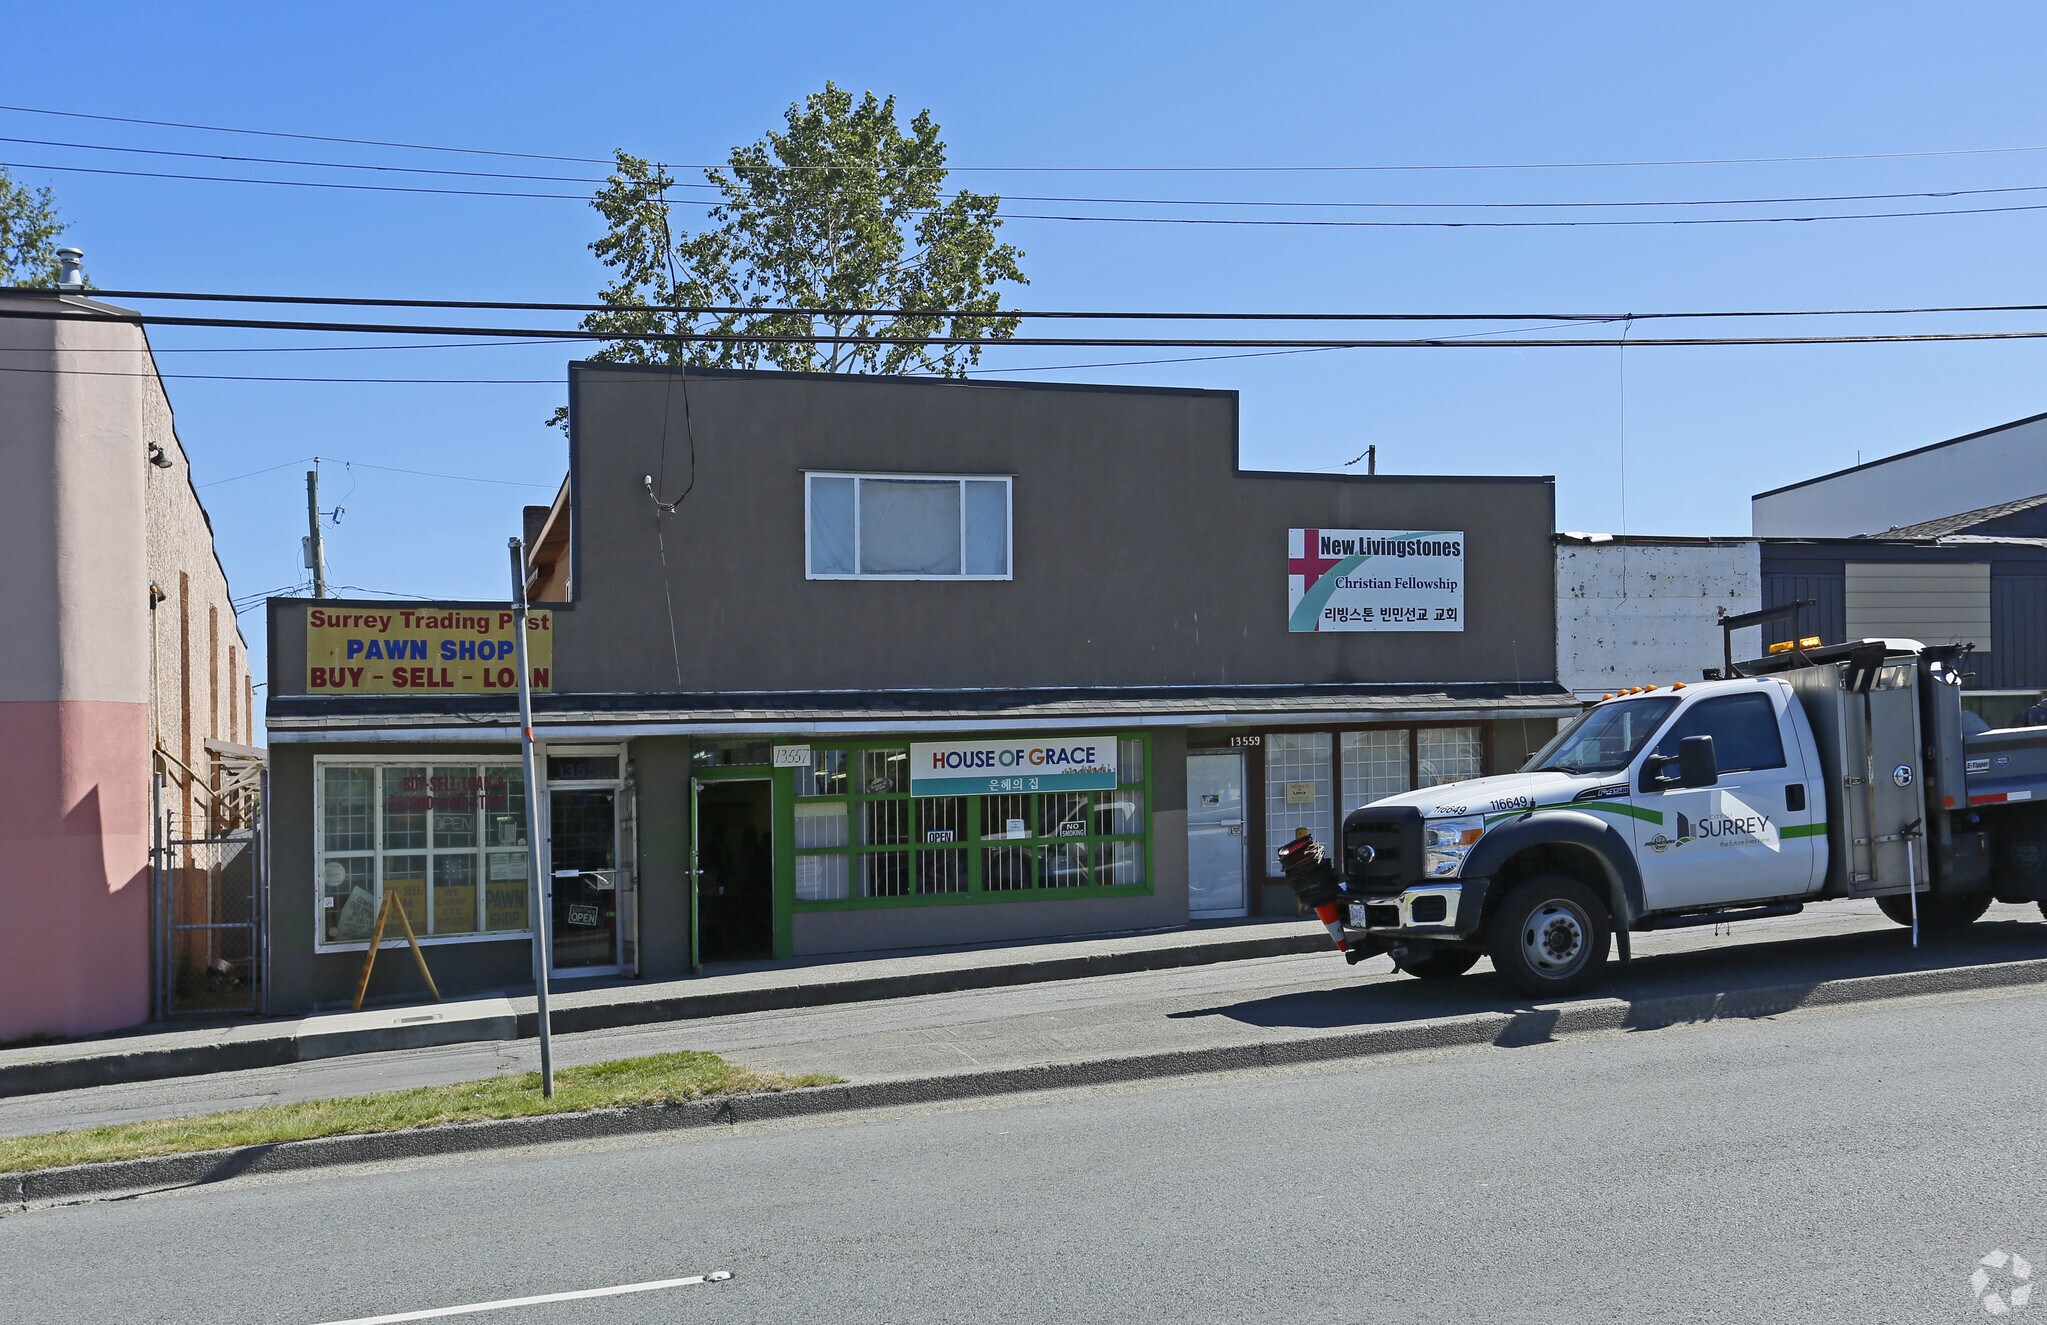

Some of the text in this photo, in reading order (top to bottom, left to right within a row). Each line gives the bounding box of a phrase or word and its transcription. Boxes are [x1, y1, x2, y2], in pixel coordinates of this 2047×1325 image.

[1320, 536, 1461, 558] New Livingstones
[1335, 576, 1458, 593] Christian Fellowship
[310, 609, 550, 634] Surrey Trading Pst
[1324, 607, 1457, 622] 리빙스톤 빈민선교 교회
[346, 639, 514, 661] PAWN SHOP
[310, 667, 364, 688] BUY
[392, 667, 454, 688] SELL
[483, 667, 549, 688] LON
[1230, 736, 1260, 747] 13559
[775, 748, 810, 764] 13557
[932, 746, 1095, 769] HOUSE OF GRACE
[988, 778, 1039, 792] 은혜의 집
[1434, 805, 1467, 815] 116649
[1489, 796, 1528, 811] 116649
[432, 816, 472, 831] OPEN
[1698, 815, 1770, 838] SURREY
[928, 832, 952, 843] OPEN
[1062, 829, 1084, 837] SMOKING
[486, 889, 524, 909] PAWN
[490, 911, 519, 927] SHOP
[571, 912, 595, 923] OPEN
